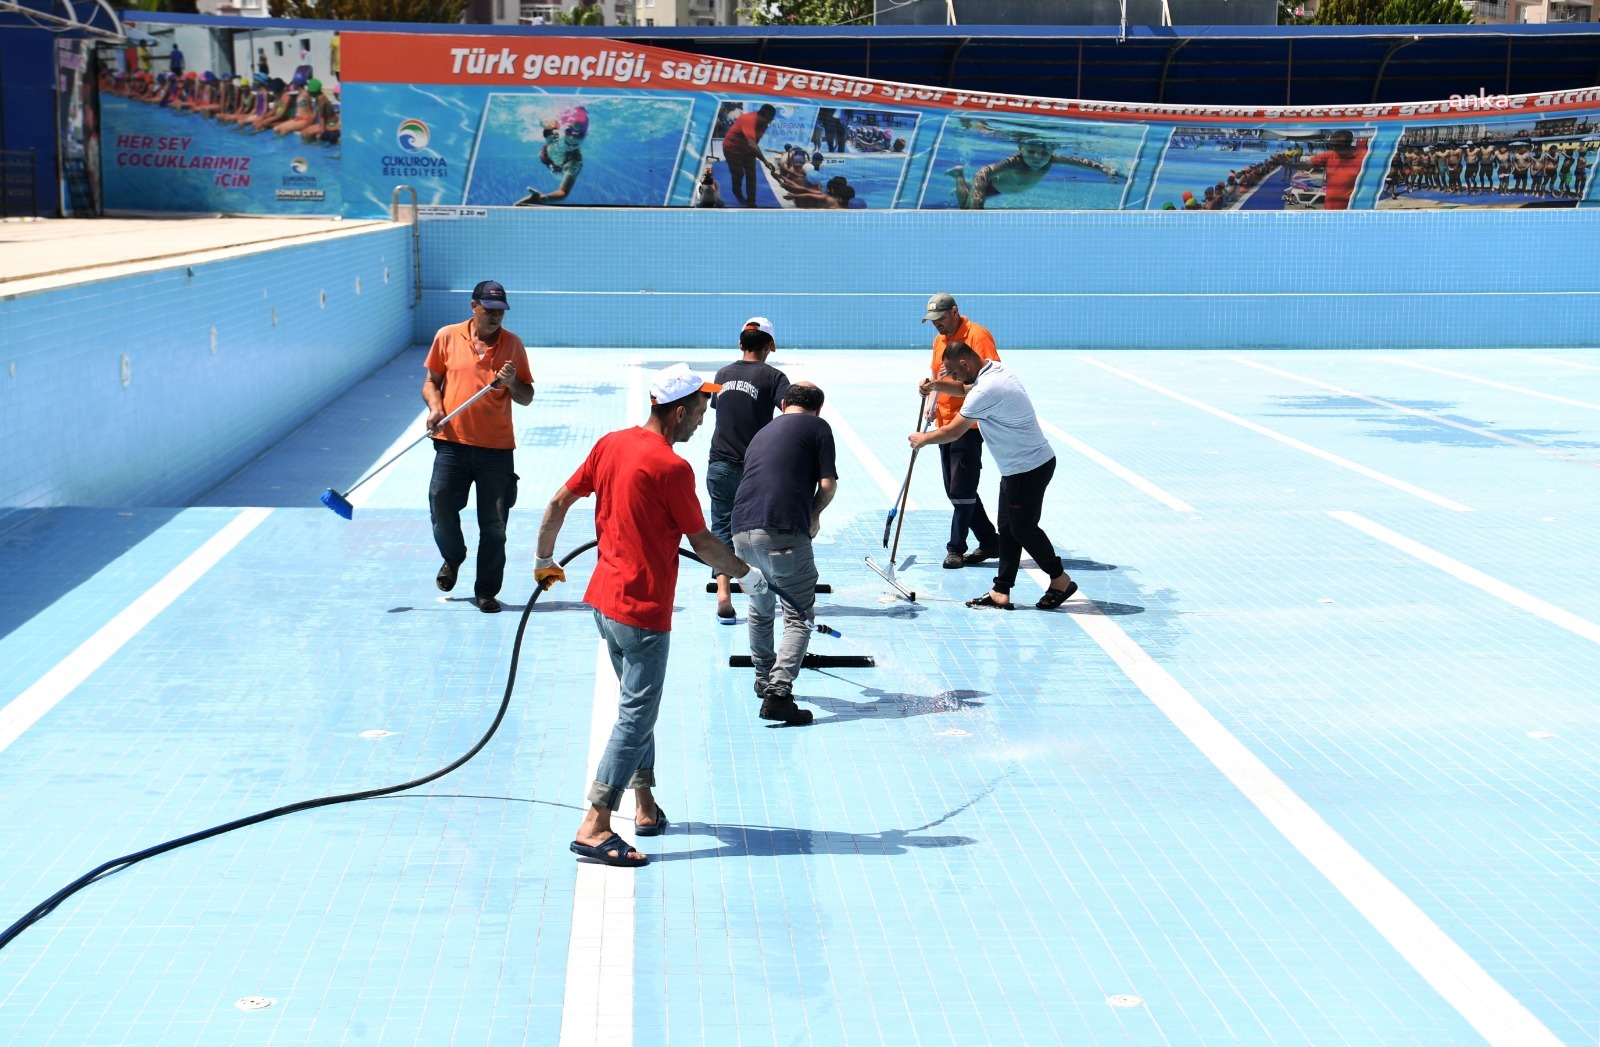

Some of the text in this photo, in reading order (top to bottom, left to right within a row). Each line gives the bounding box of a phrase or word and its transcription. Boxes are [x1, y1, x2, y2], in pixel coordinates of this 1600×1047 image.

[450, 47, 518, 75] Türk
[522, 50, 652, 83] gençliği,
[659, 58, 767, 86] sağlıklı
[116, 134, 192, 152] HER ŞEY
[116, 152, 251, 171] ÇOCUKLARIMIZ
[381, 155, 447, 168] ÇUKUROVA
[383, 167, 448, 177] BELEDİYESİ
